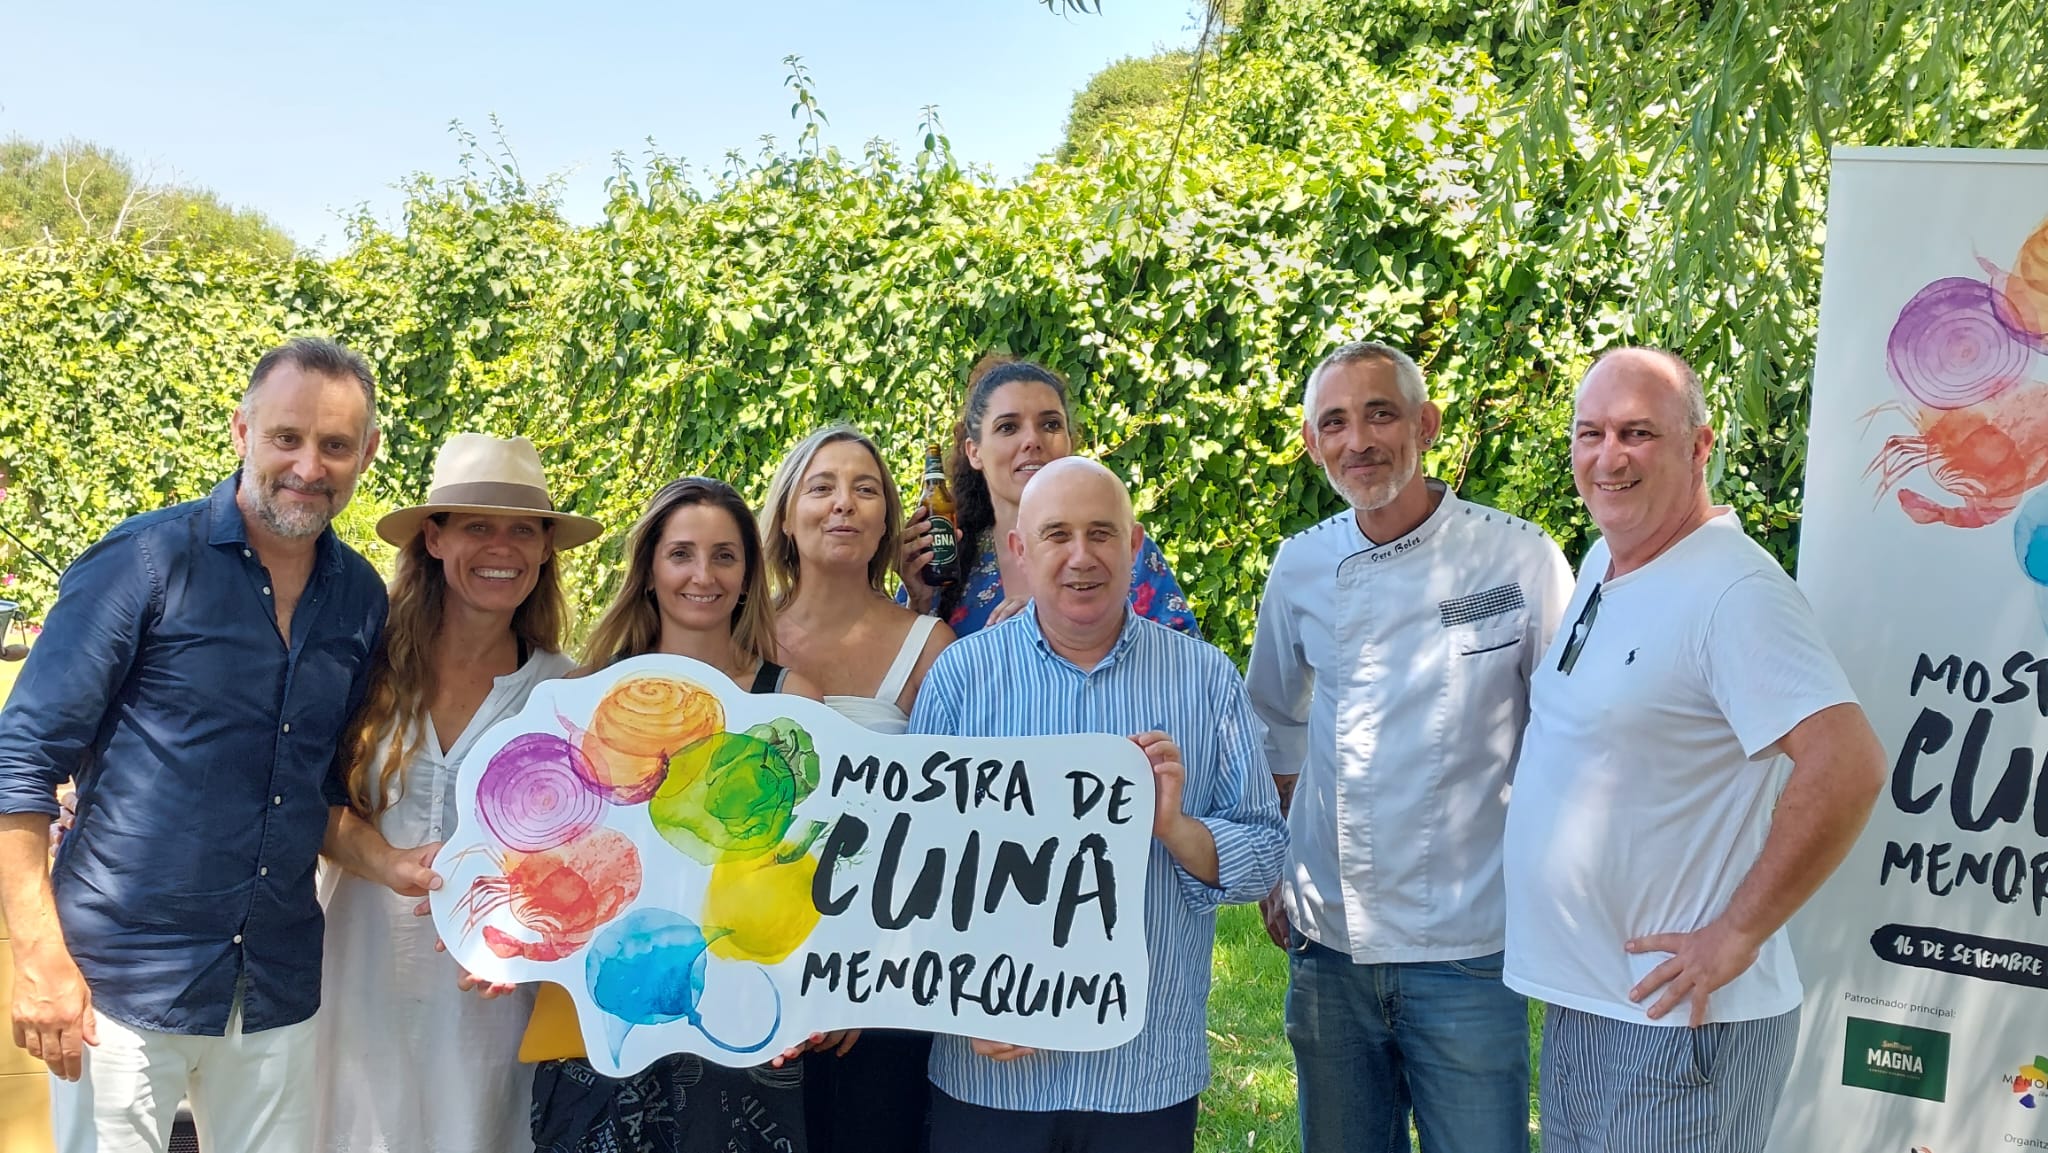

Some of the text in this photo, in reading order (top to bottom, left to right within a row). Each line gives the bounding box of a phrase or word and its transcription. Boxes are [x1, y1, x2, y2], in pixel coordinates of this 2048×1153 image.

[831, 750, 1135, 825] MOSTRA DE
[811, 812, 1118, 948] CUINA
[1893, 935, 2044, 977] 16 DE SETEMBRE
[800, 950, 1127, 1025] MENORQUINA
[1844, 991, 1957, 1019] Patrocinador principal:
[1866, 1047, 1924, 1074] MAGNA
